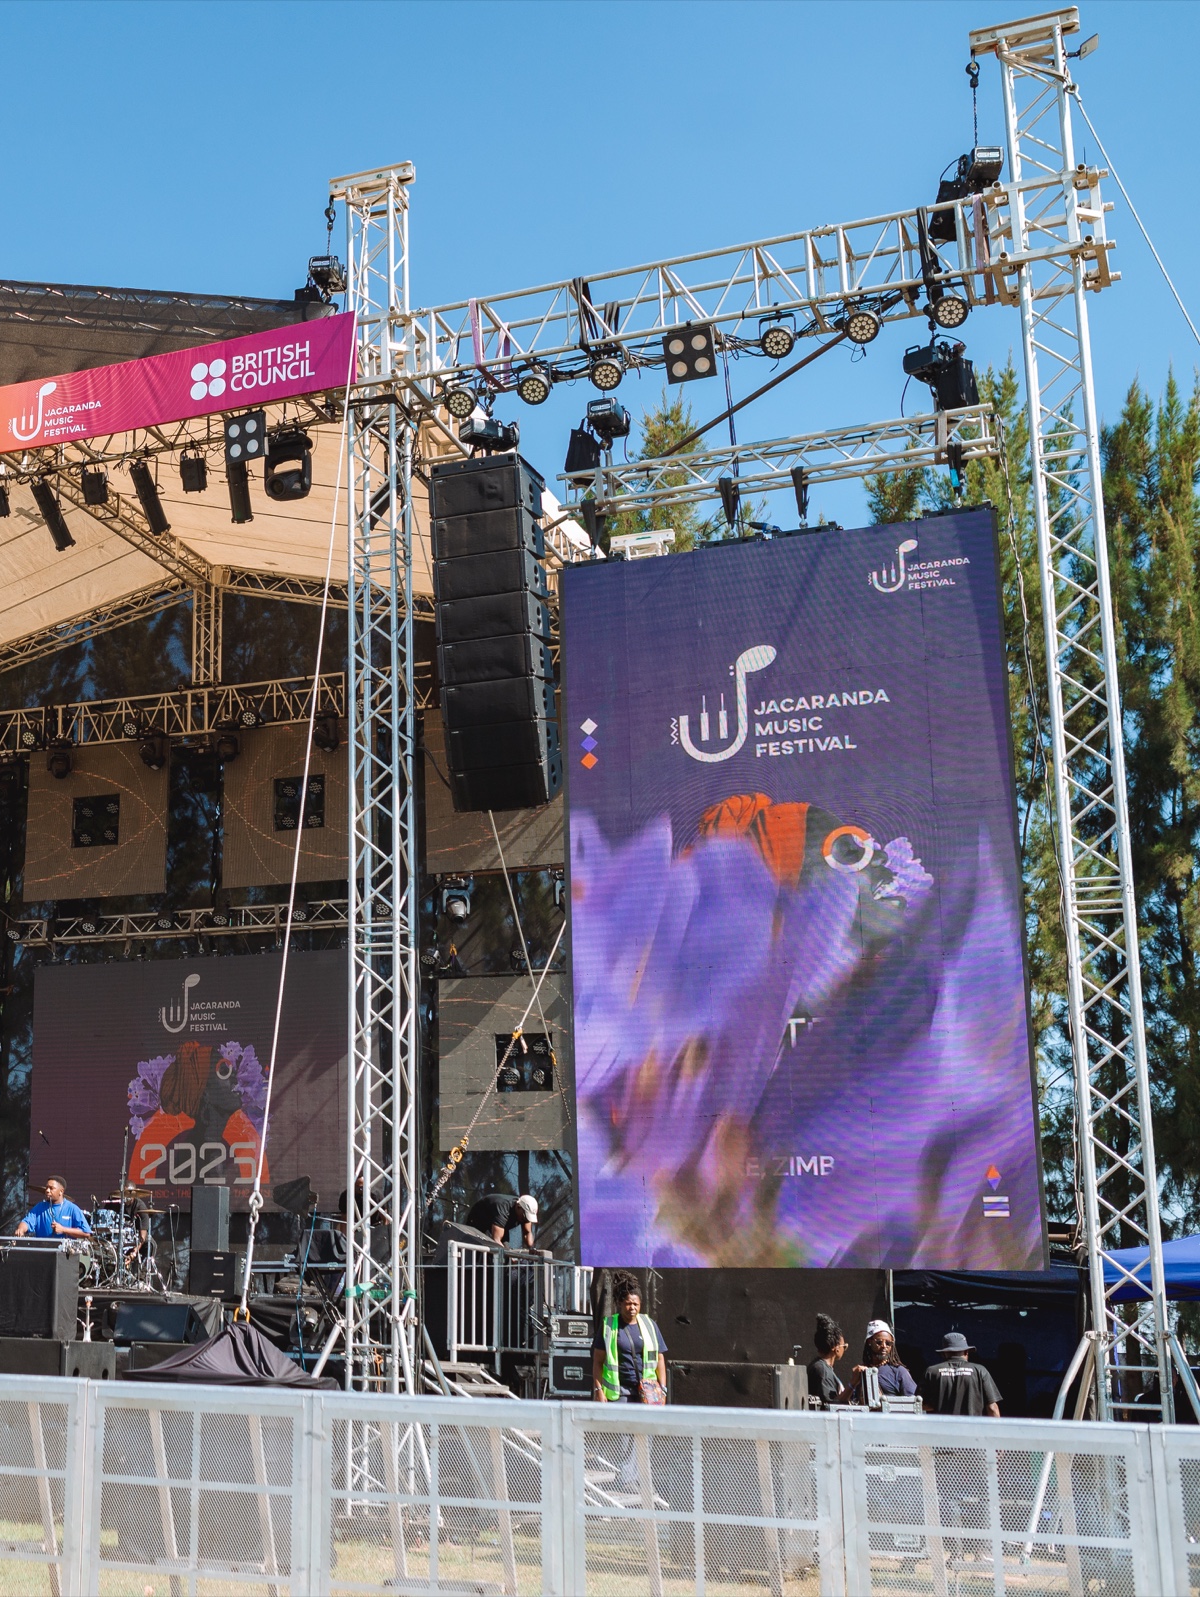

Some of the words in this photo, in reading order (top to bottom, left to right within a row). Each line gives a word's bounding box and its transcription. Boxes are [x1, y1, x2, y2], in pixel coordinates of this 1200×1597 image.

[232, 340, 310, 374] BRITISH
[230, 359, 315, 392] COUNCIL
[44, 400, 102, 417] JACARANDA
[44, 415, 74, 427] MUSIC
[44, 423, 87, 438] FESTIVAL
[907, 557, 971, 572] JACARANDA
[907, 570, 940, 581] MUSIC
[908, 578, 956, 590] FESTIVAL
[753, 688, 891, 716] JACARANDA
[754, 716, 823, 737] MUSIC
[755, 735, 858, 758] FESTIVAL
[190, 1000, 241, 1011] JACARANDA
[190, 1012, 216, 1021] MUSIC
[189, 1023, 228, 1032] FESTIVAL
[139, 1141, 257, 1185] 2025
